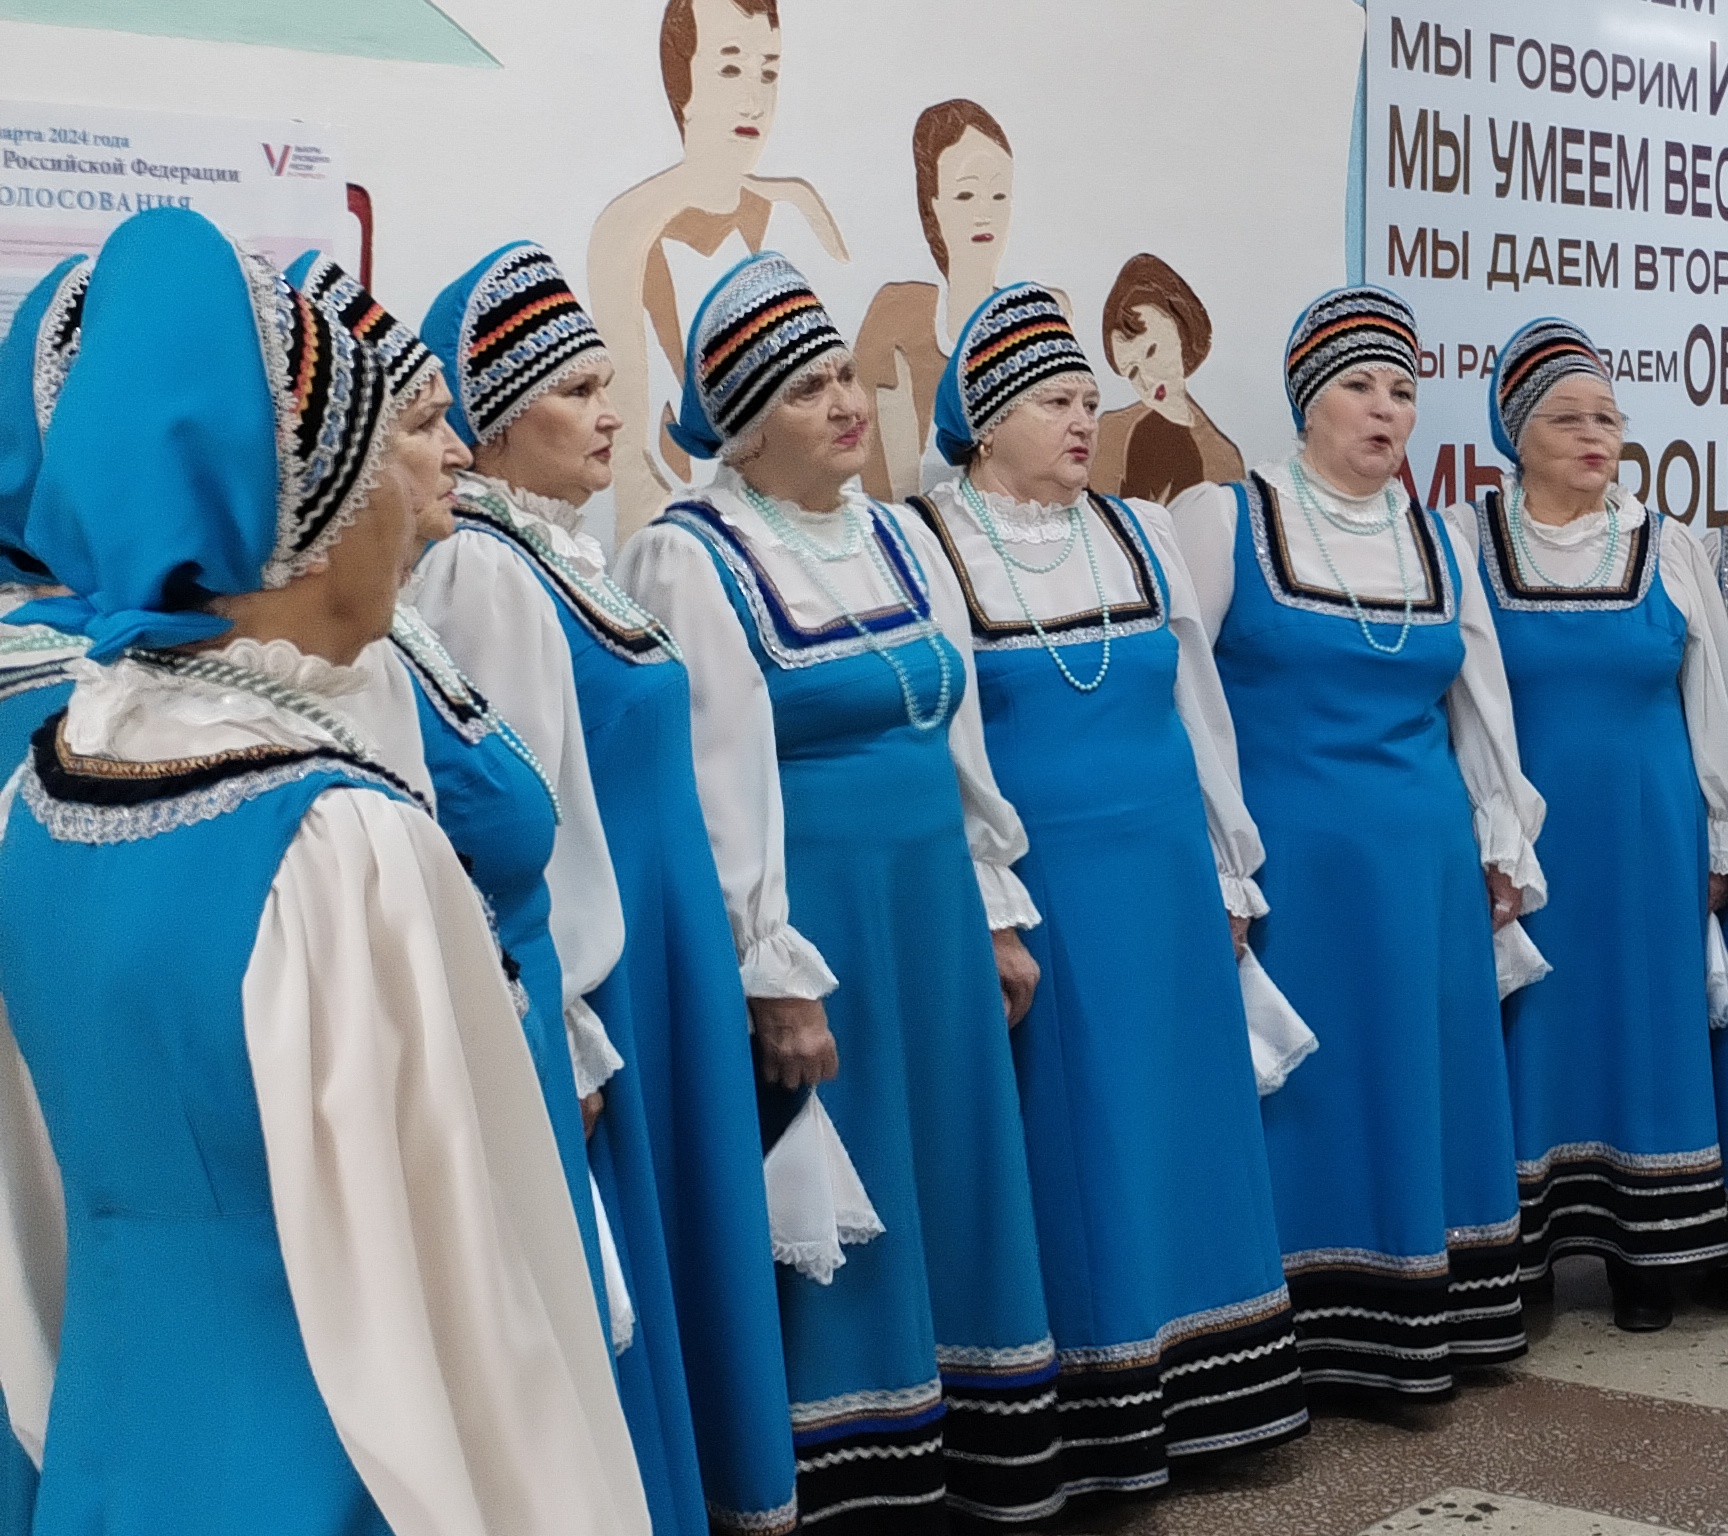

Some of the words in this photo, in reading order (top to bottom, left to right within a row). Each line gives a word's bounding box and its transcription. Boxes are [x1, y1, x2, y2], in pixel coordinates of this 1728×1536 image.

[1390, 16, 1472, 80] МЫ
[1489, 32, 1698, 112] ГОВОРИМ
[49, 127, 88, 145] 2024
[92, 134, 131, 149] года
[1387, 104, 1471, 195] МЫ
[1488, 117, 1649, 213] УМЕЕМ
[3, 149, 127, 175] Российской
[130, 158, 242, 185] Федерации
[1387, 224, 1469, 280] МЫ
[1487, 233, 1619, 292] ДАЕМ
[1418, 344, 1444, 378] Ы
[1458, 344, 1678, 383] РАВАЕМ
